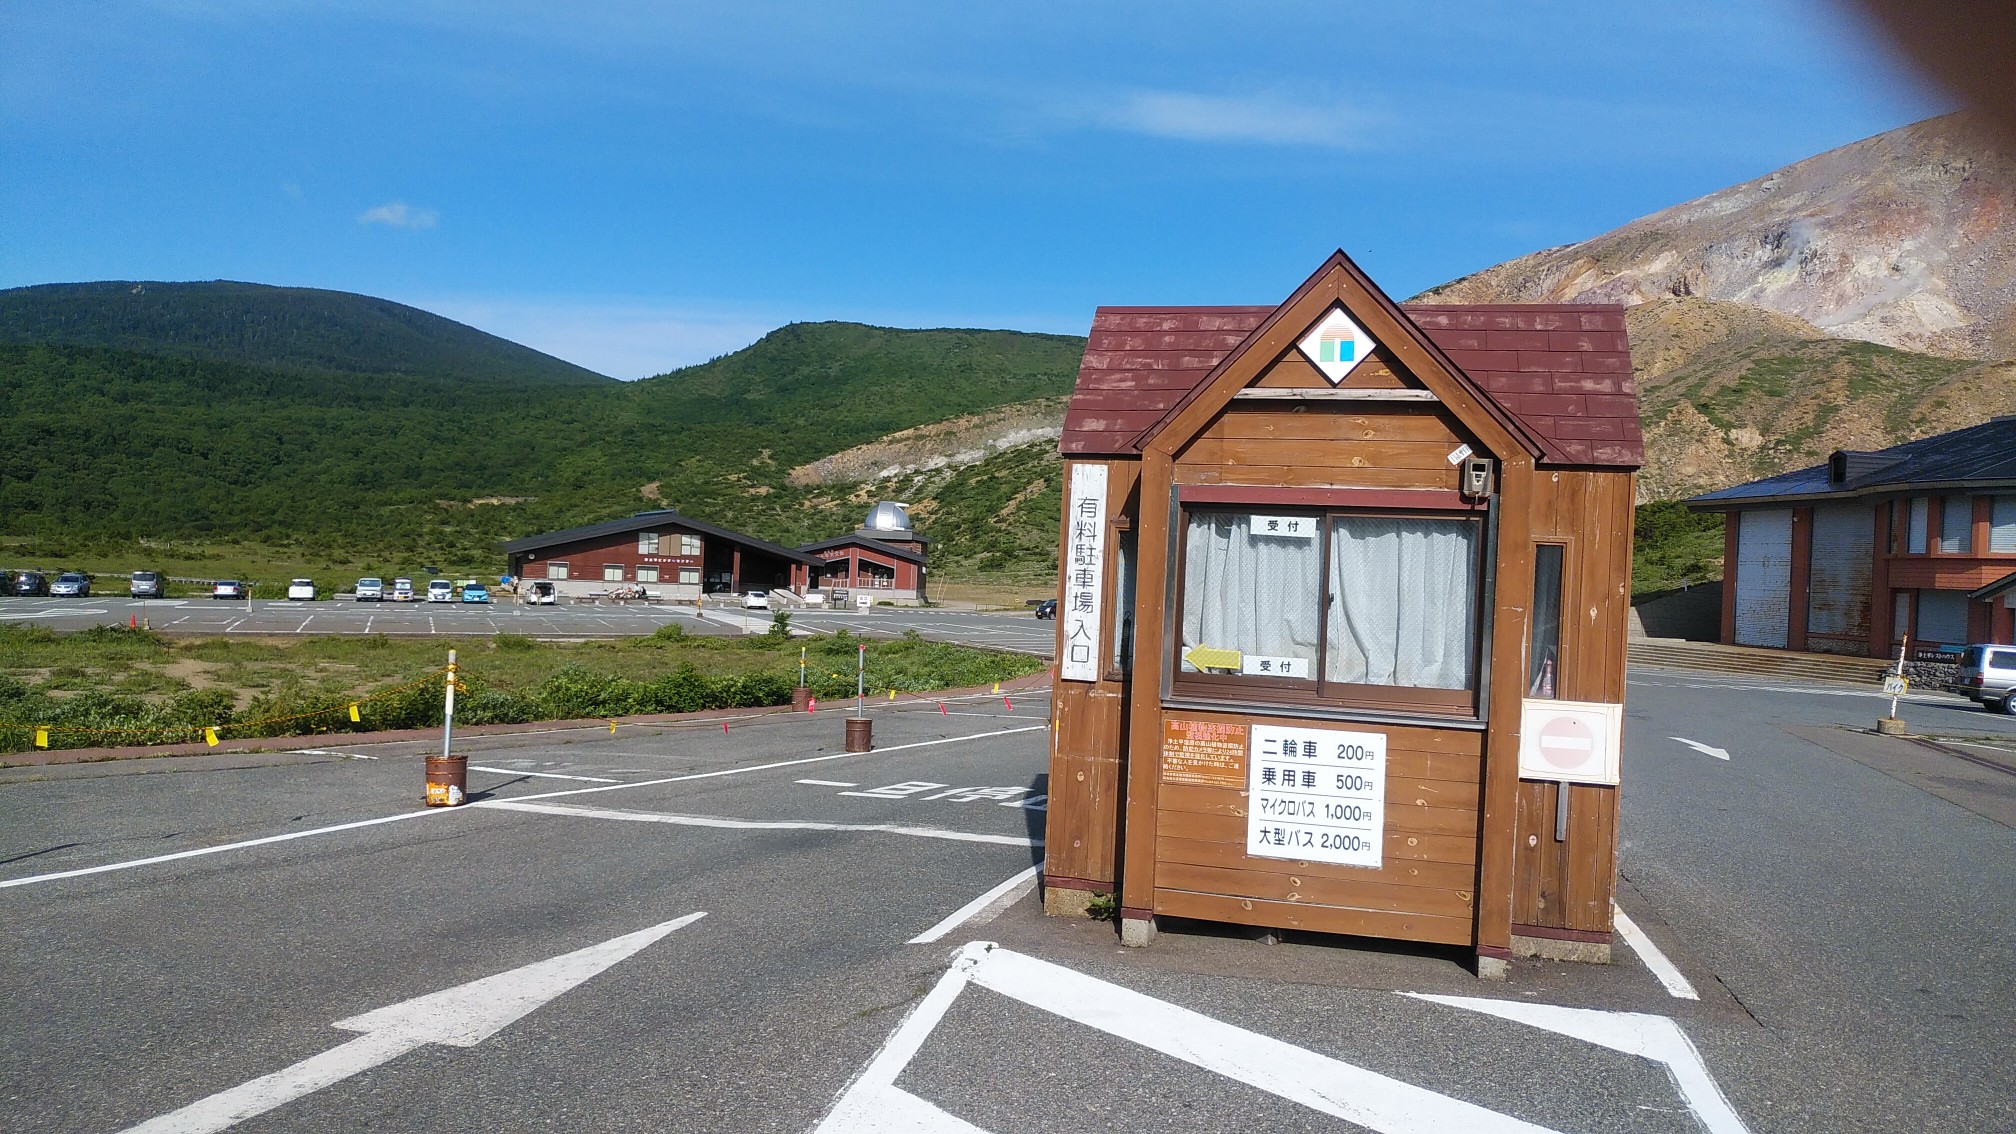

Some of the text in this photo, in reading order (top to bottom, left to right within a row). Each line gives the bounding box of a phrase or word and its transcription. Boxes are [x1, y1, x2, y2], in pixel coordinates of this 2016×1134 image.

[1267, 520, 1300, 532] 受付
[1070, 497, 1099, 663] 有料駐車場入口
[1259, 660, 1292, 673] 受付
[1886, 683, 1904, 693] バイク
[1262, 739, 1374, 760] 二輪車 200円
[1261, 767, 1317, 788] 乗用車
[1336, 774, 1373, 791] 500円
[1260, 798, 1372, 821] マイクロバス 1,000円
[1259, 826, 1371, 851] 大型バス 2,000円
